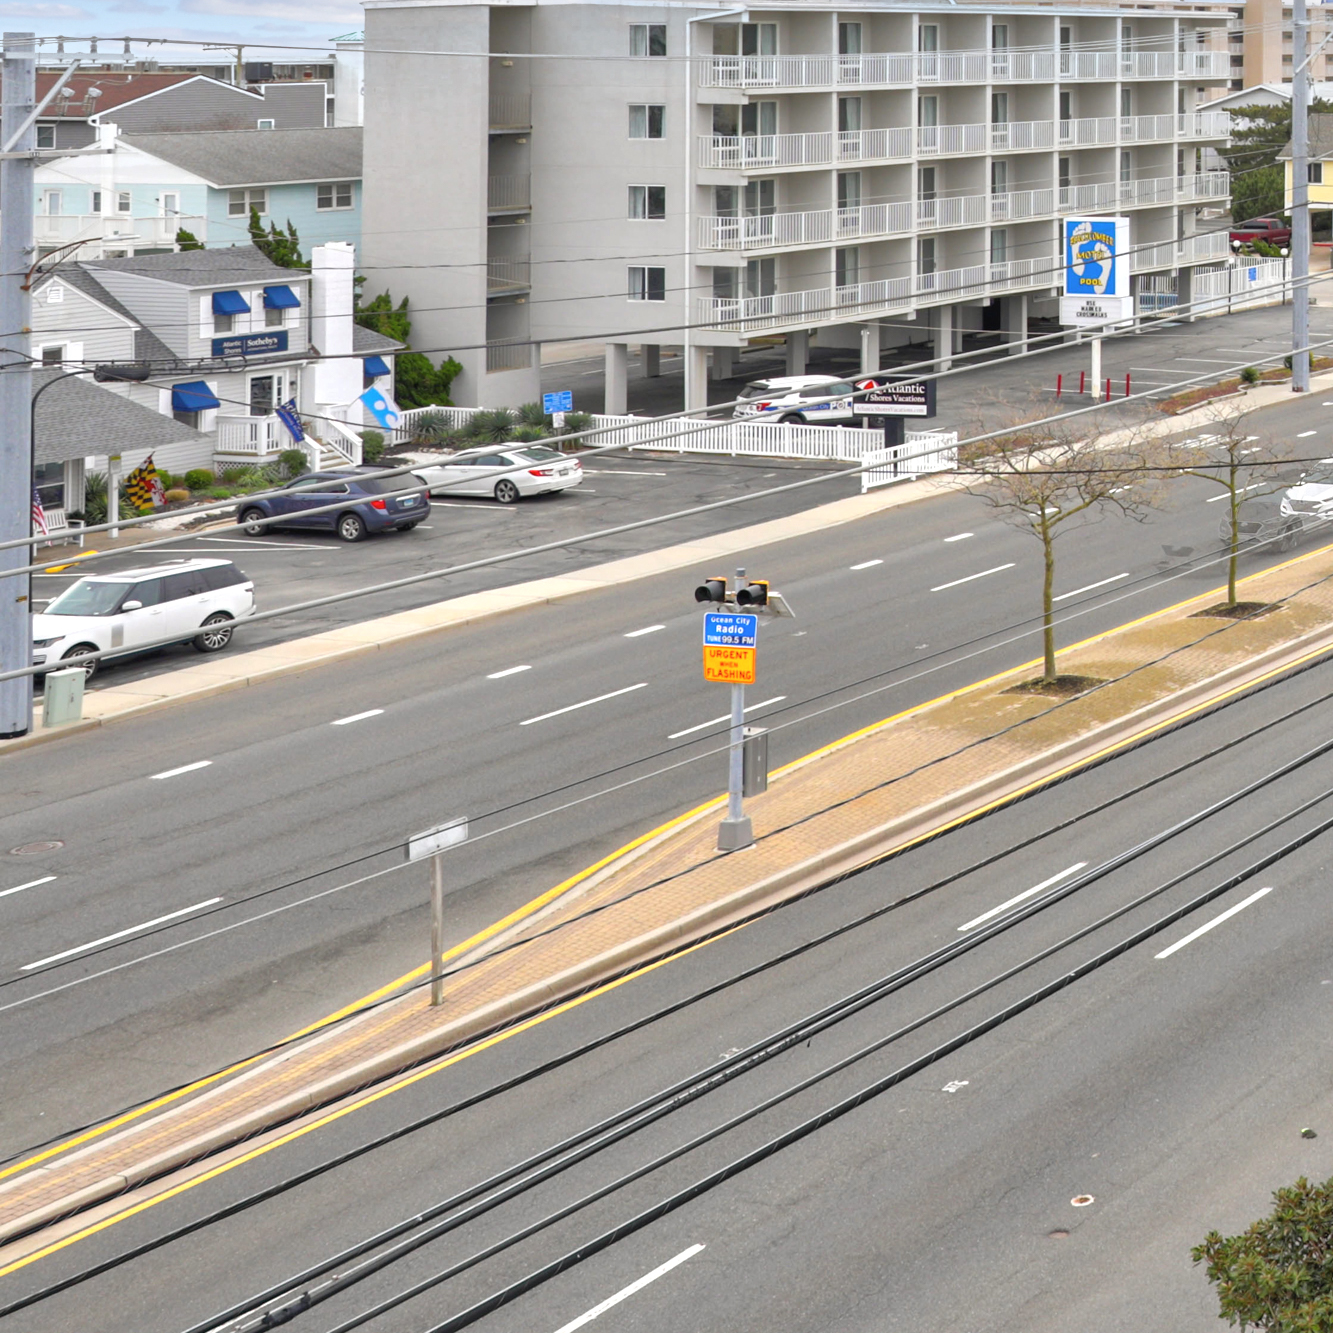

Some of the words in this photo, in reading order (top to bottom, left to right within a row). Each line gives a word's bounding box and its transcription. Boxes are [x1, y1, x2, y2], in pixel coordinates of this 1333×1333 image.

[1076, 250, 1105, 260] MOTEL
[1080, 278, 1103, 286] POOL
[247, 337, 278, 347] Sotheby's
[883, 382, 926, 393] Atlantic
[870, 394, 892, 402] Shores
[893, 394, 925, 402] Vacations
[736, 617, 750, 625] City
[716, 625, 744, 634] Radio
[722, 635, 739, 644] 99.5
[742, 637, 754, 645] FM
[709, 650, 748, 659] URGENT
[707, 668, 752, 680] FLASHING
